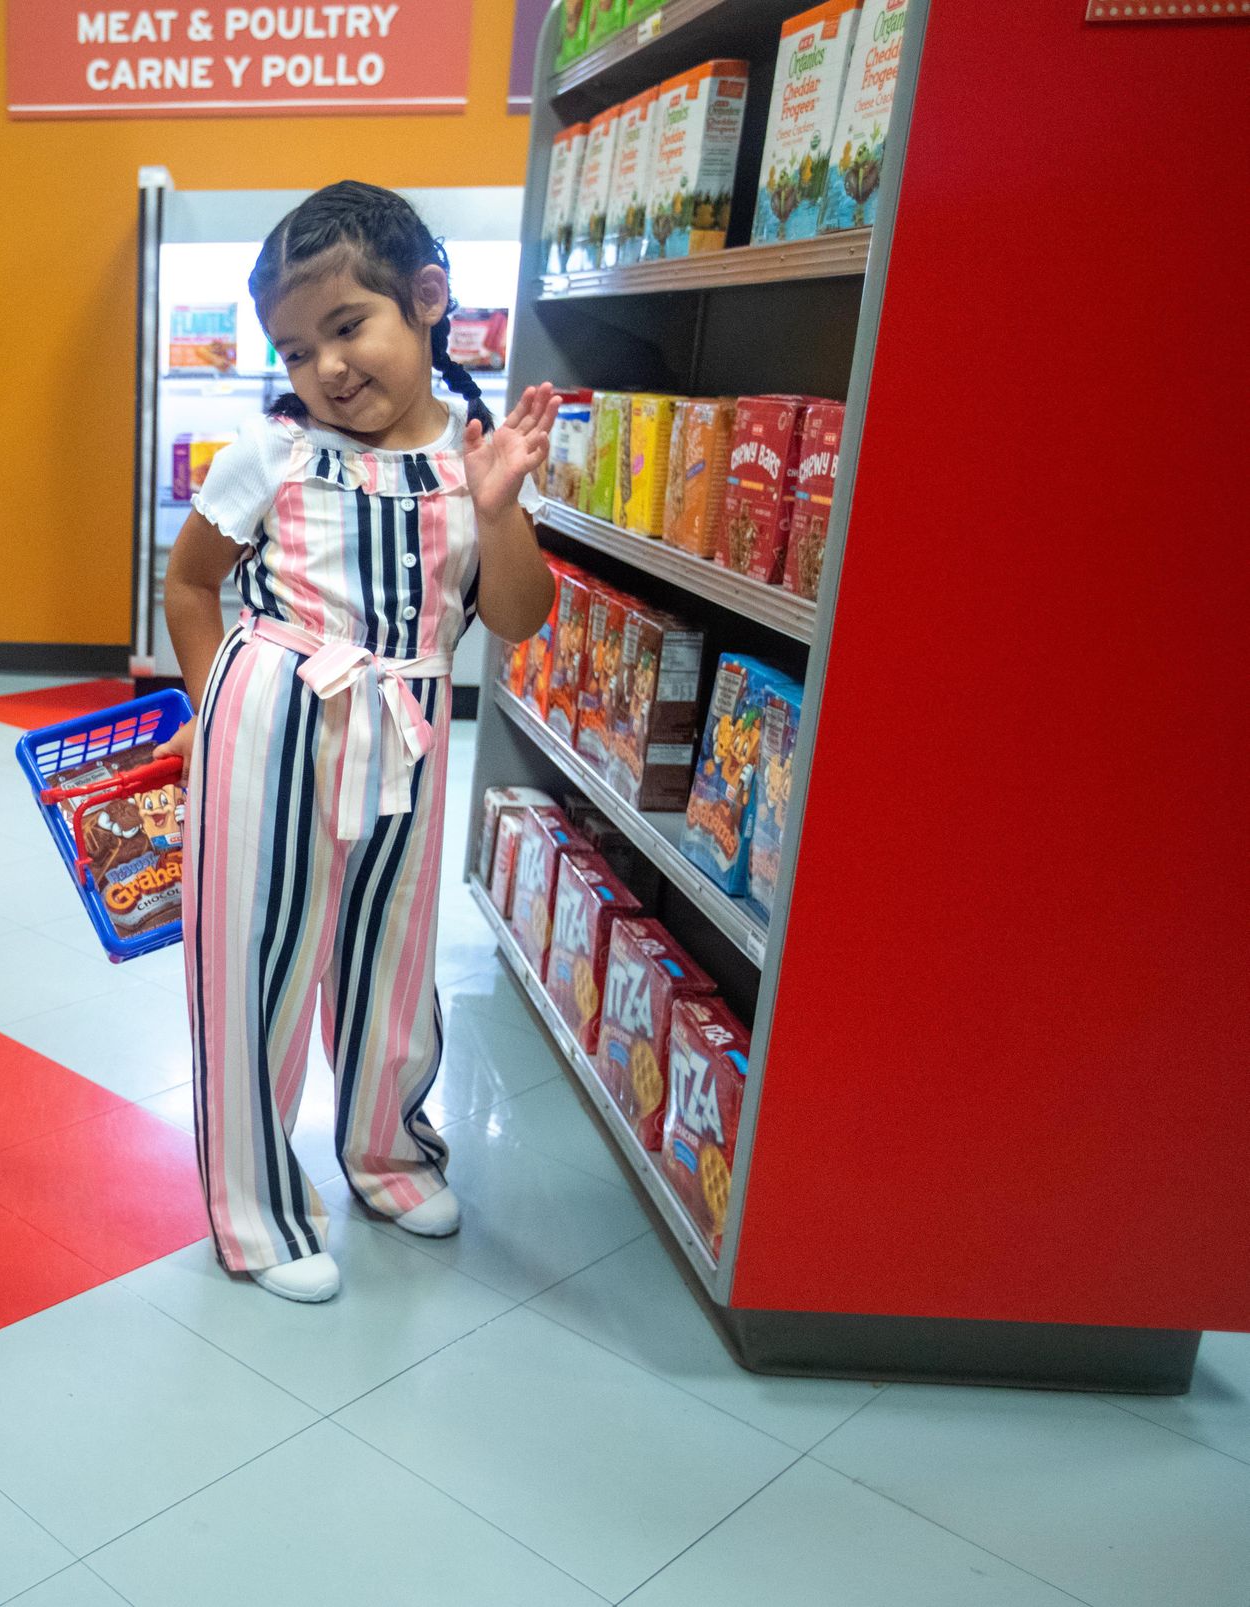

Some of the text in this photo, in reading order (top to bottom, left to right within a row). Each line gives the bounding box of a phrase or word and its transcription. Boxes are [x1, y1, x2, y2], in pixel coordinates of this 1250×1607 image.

[77, 5, 399, 44] MEAT & POULTRY
[86, 53, 385, 91] CARNE Y POLLO
[137, 888, 180, 911] CHOCOL
[605, 958, 654, 1038] ITZA
[670, 1050, 725, 1145] ITZA
